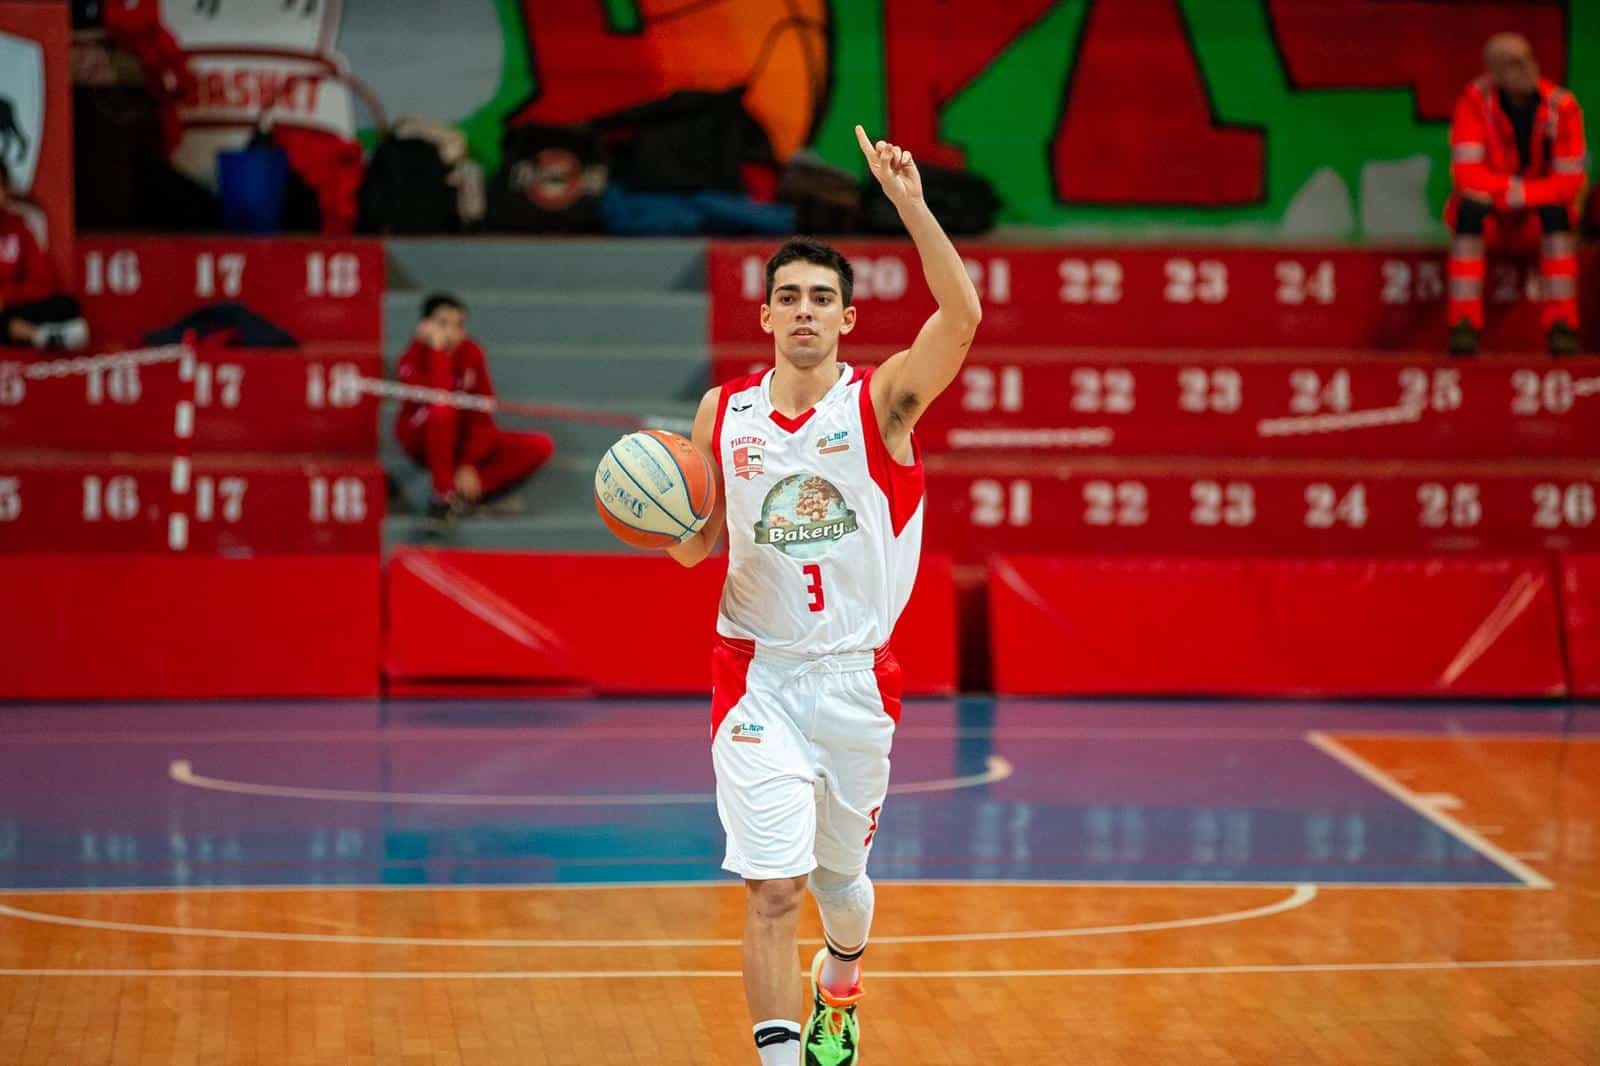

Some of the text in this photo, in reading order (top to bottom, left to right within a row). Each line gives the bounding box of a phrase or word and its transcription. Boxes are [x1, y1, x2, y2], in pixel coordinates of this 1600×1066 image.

[86, 252, 360, 297] 16 17 18
[1059, 259, 1123, 304] 22
[1164, 259, 1228, 304] 23
[1275, 260, 1336, 305] 24
[1381, 260, 1442, 304] 25
[196, 363, 243, 407] 17
[962, 367, 1022, 412] 21
[1071, 368, 1135, 414] 22
[1178, 367, 1242, 413] 23
[1290, 368, 1351, 413] 24
[1399, 368, 1462, 413] 25
[84, 476, 139, 521] 16
[196, 477, 246, 522] 17
[310, 477, 366, 522] 18
[970, 480, 1596, 529] 21 22 23 24 25 26
[769, 522, 845, 543] Bakery
[803, 564, 825, 612] 3
